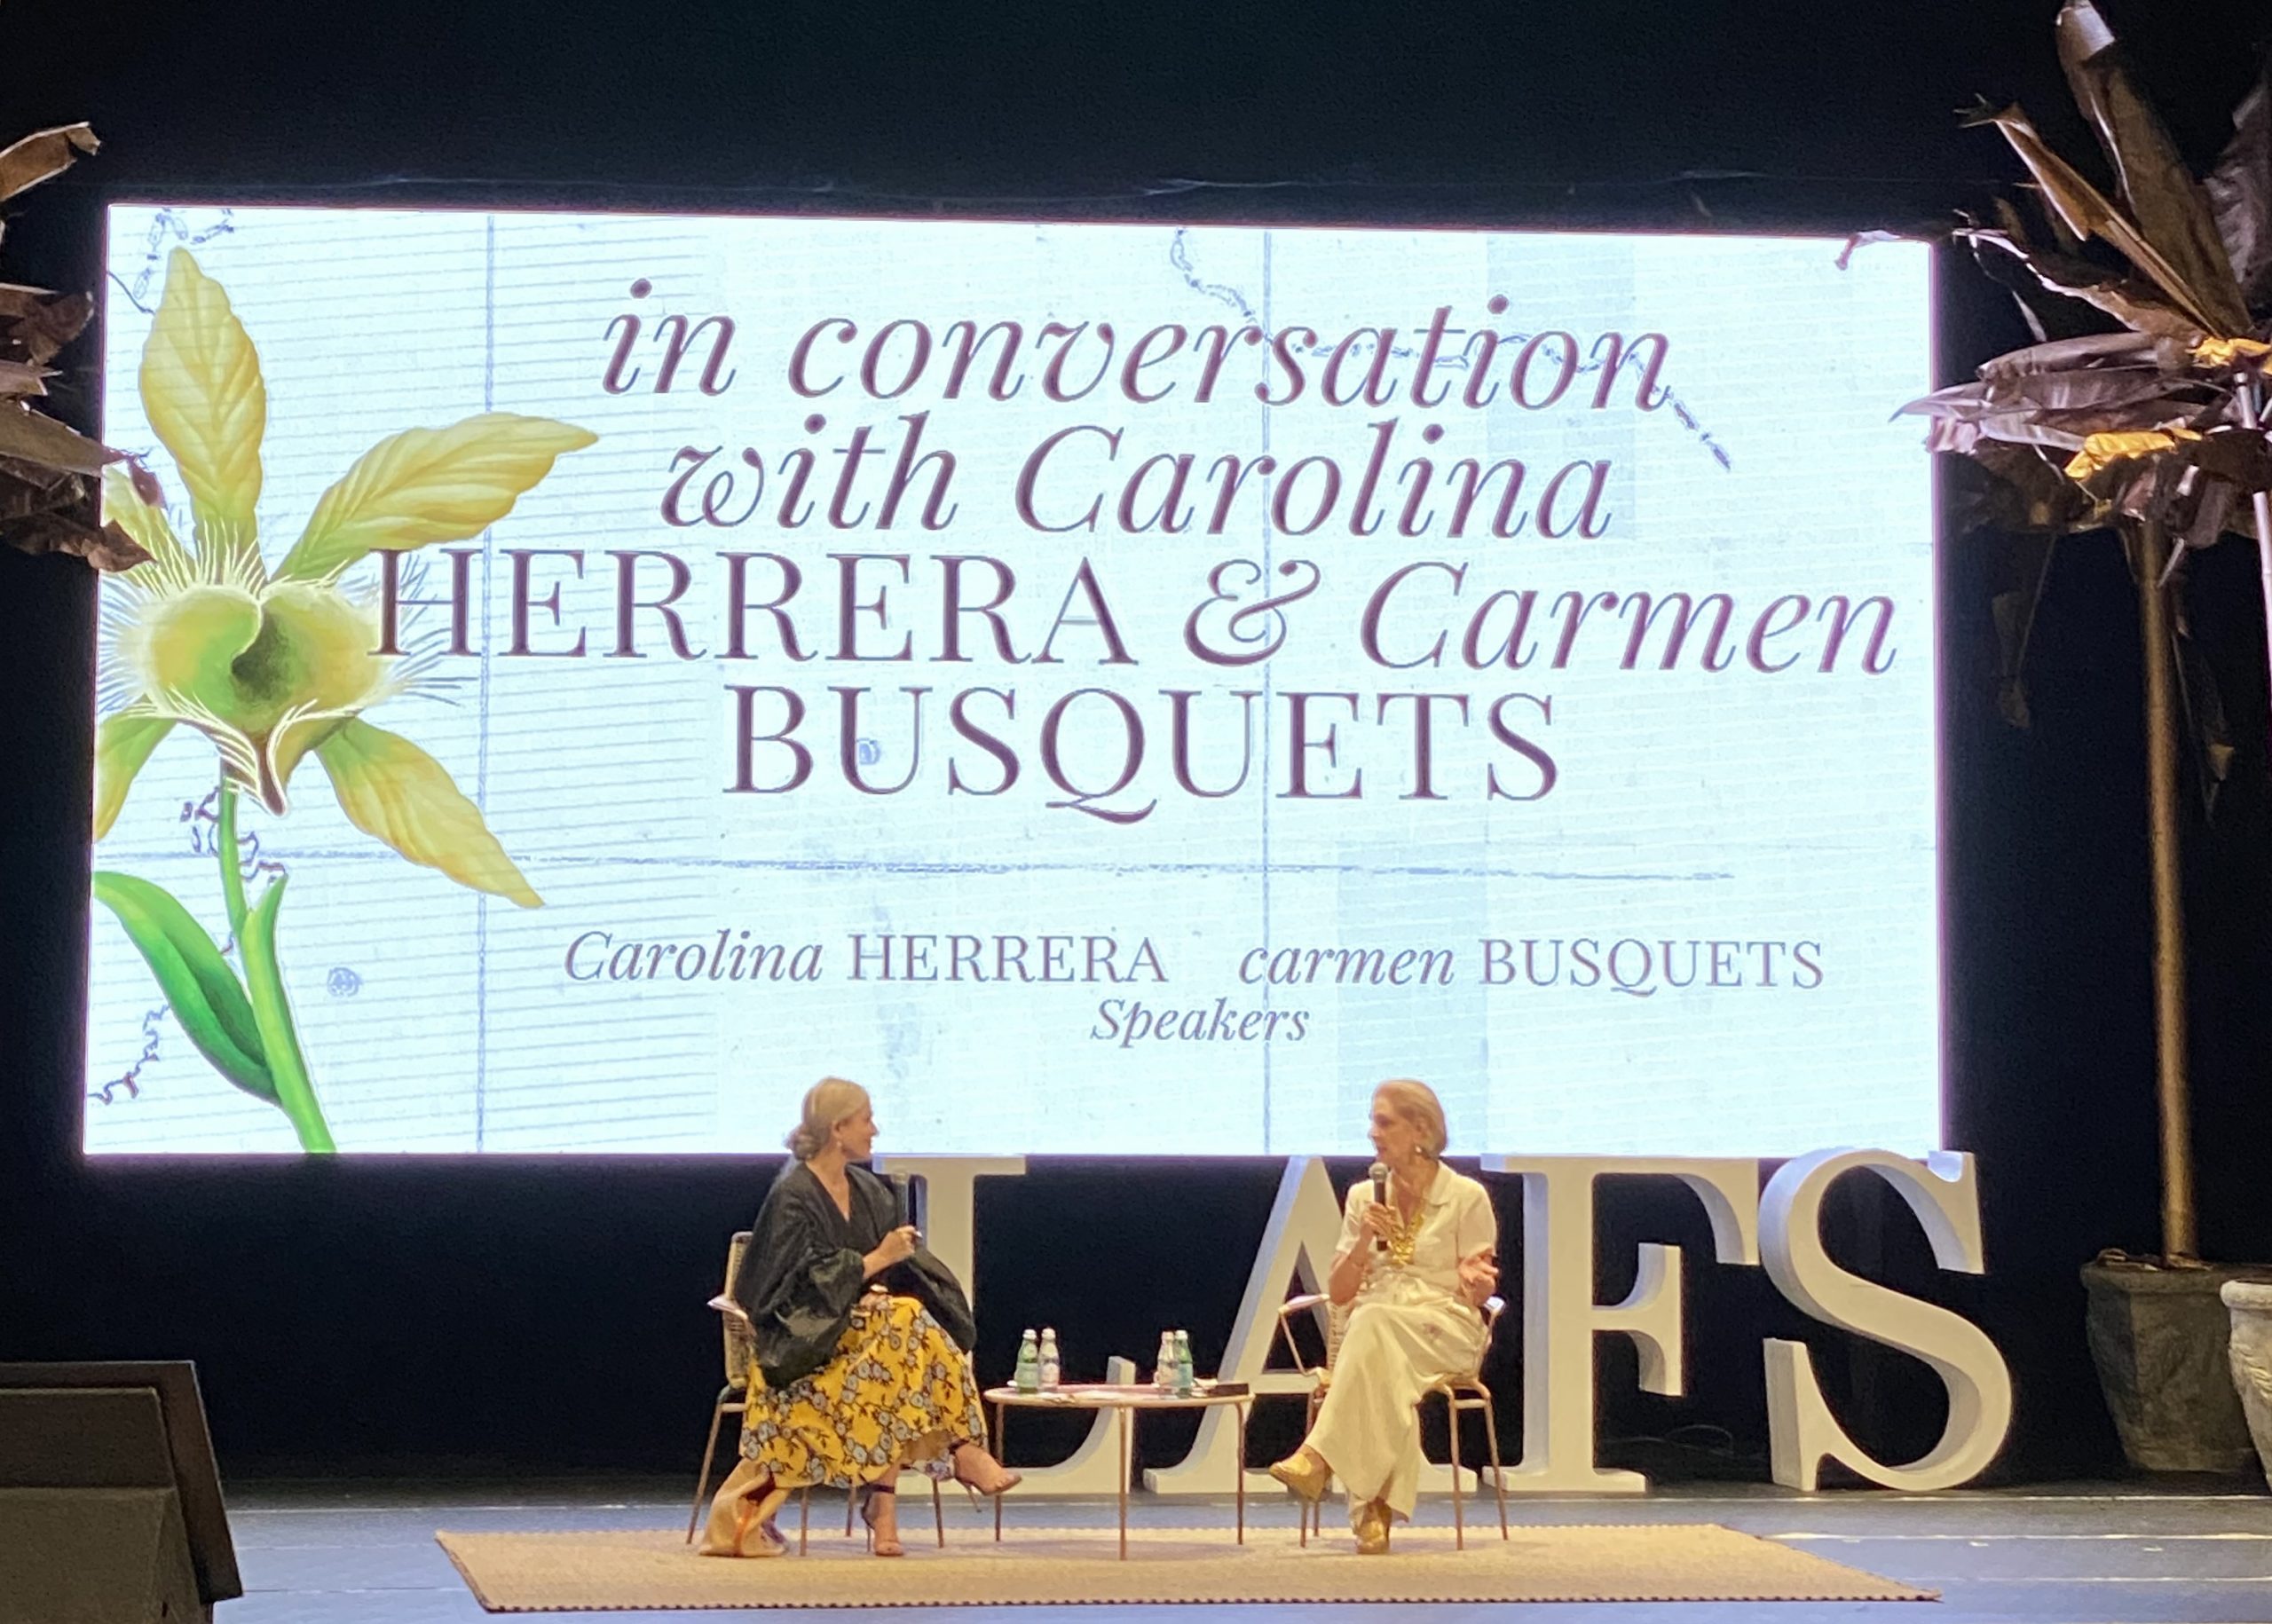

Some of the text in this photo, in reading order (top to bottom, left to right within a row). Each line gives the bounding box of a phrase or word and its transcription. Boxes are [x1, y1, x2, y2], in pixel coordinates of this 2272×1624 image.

[601, 277, 1671, 412] in conversation
[659, 409, 1613, 540] with Carolina
[367, 547, 1899, 676] HERRERA & Carmen
[722, 683, 1559, 824] BUSQUETS
[564, 927, 1825, 997] Carolina HERRERA carmen BUSQUETS
[1089, 996, 1311, 1049] Speakers
